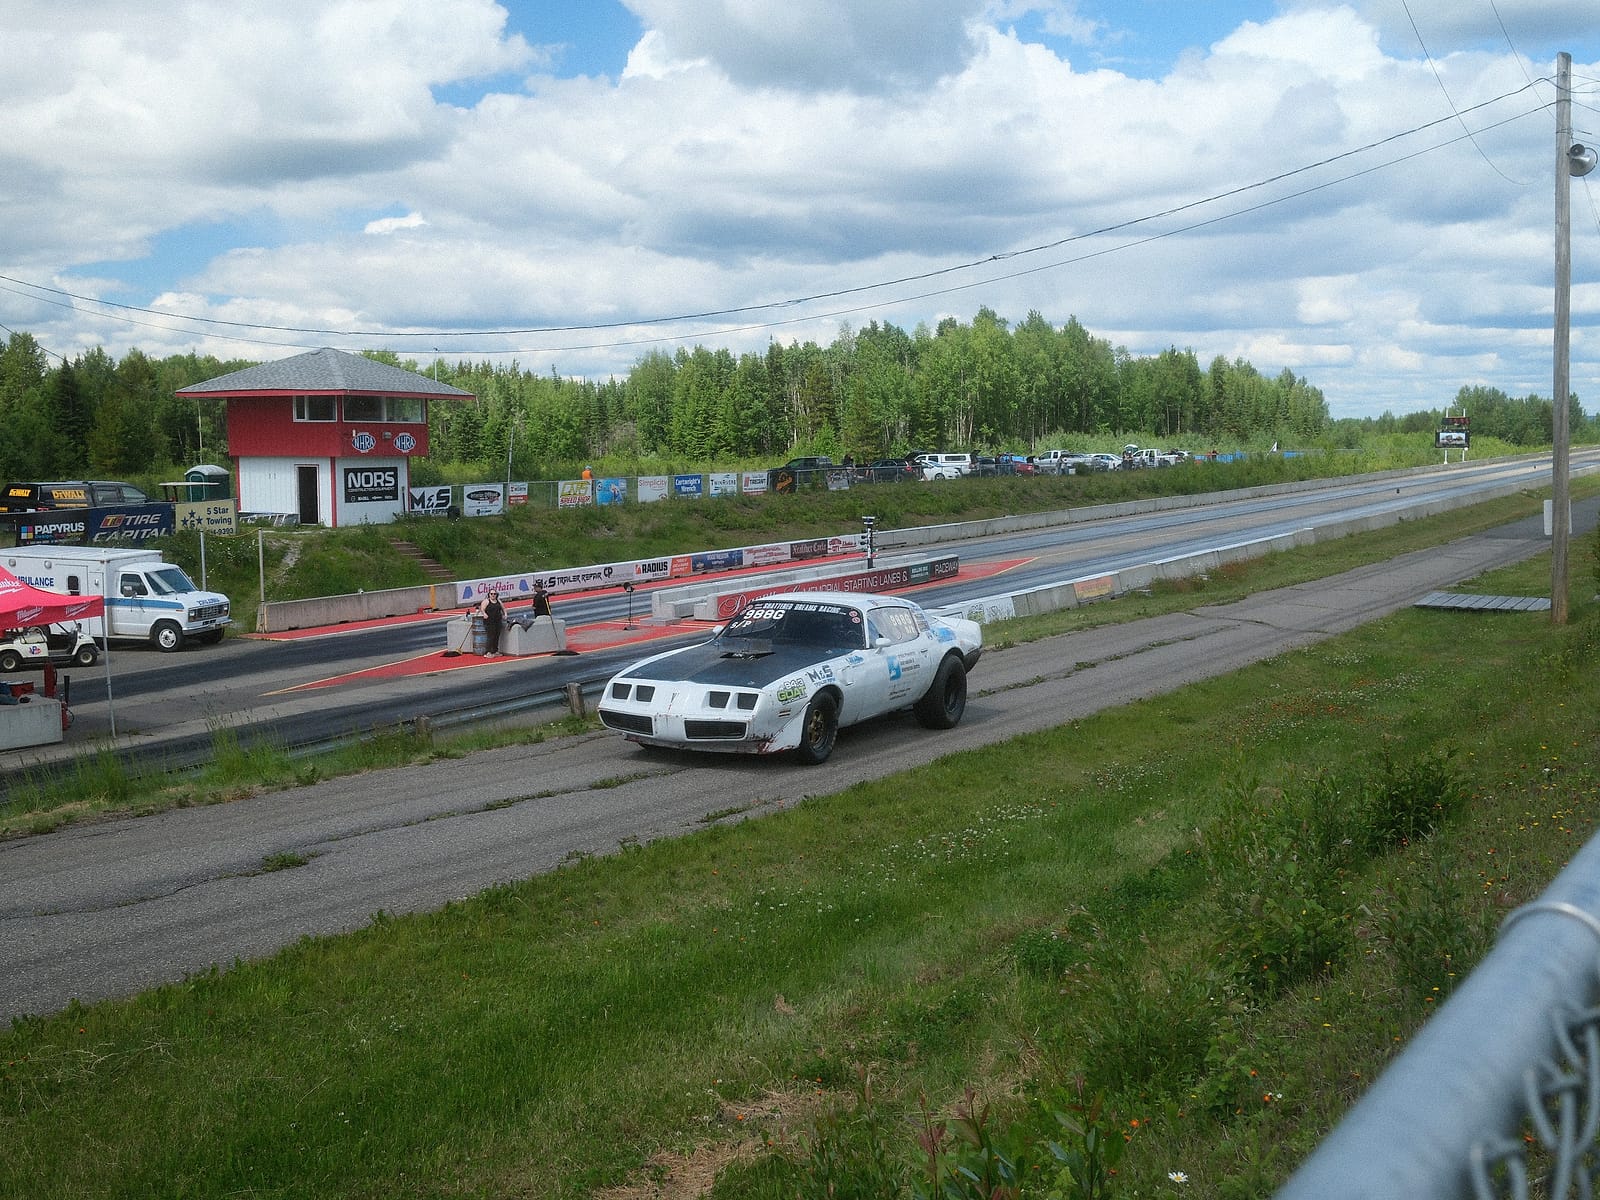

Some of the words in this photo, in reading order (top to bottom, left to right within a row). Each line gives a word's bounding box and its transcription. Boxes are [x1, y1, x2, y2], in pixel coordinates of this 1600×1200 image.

[355, 434, 374, 450] NHRA
[396, 435, 415, 450] NHRA
[347, 471, 395, 488] NORS
[639, 479, 667, 489] Simplicity
[409, 488, 450, 510] M&S
[206, 507, 212, 515] 5
[213, 506, 229, 515] Star
[125, 513, 162, 526] TIRE
[206, 517, 232, 526] Towing
[34, 521, 85, 535] PAPYRUS
[92, 527, 170, 542] CAPITAL
[642, 561, 668, 574] RADIUS
[557, 574, 580, 585] TRAILER
[581, 571, 602, 583] REPAIR
[803, 582, 841, 592] MORIAL
[843, 576, 878, 592] STARTING
[879, 571, 901, 586] LANES
[902, 570, 909, 582] &
[477, 581, 515, 594] Chieftain
[744, 609, 786, 620] 988G
[763, 602, 794, 610] SHATTERED
[794, 603, 818, 612] DREAMS
[818, 605, 842, 614] RACING
[806, 664, 833, 683] M&S
[777, 686, 807, 702] GOAT
